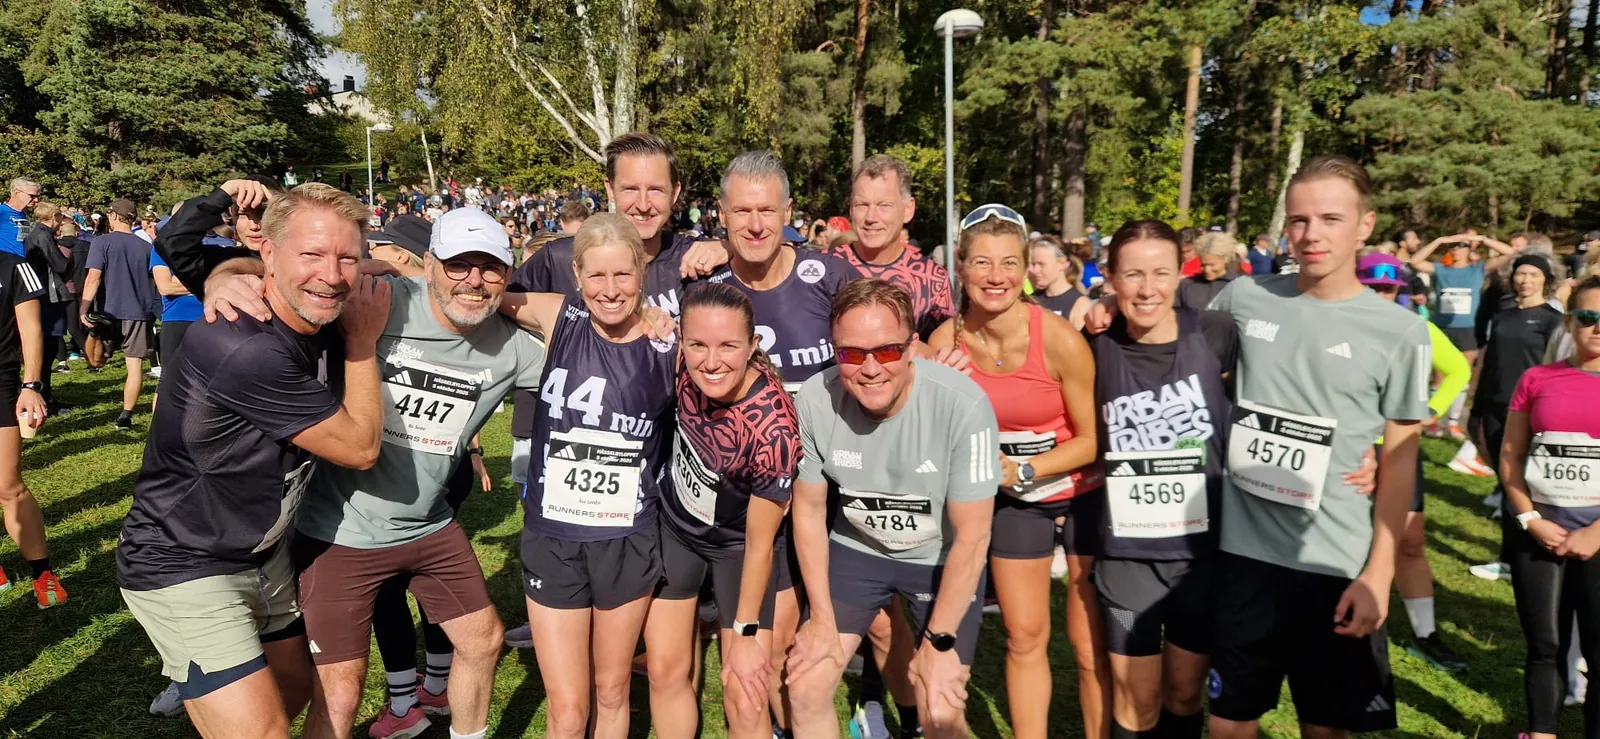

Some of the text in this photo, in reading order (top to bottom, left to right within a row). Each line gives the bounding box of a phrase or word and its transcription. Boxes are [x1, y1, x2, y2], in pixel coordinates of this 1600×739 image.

[394, 393, 455, 423] 4147
[540, 367, 607, 427] 44
[1101, 373, 1208, 427] URBAN
[383, 427, 420, 442] NNERS
[1108, 408, 1215, 453] TRIBES
[1246, 437, 1306, 471] 4570
[564, 467, 620, 495] 4325
[676, 453, 701, 499] 4306
[1543, 462, 1591, 482] 1666
[1129, 482, 1186, 505] 4569
[1276, 487, 1314, 500] STORE
[548, 504, 631, 519] RUNNERS STORE
[864, 514, 918, 531] 4784
[1118, 518, 1204, 529] RUNNERS STORE
